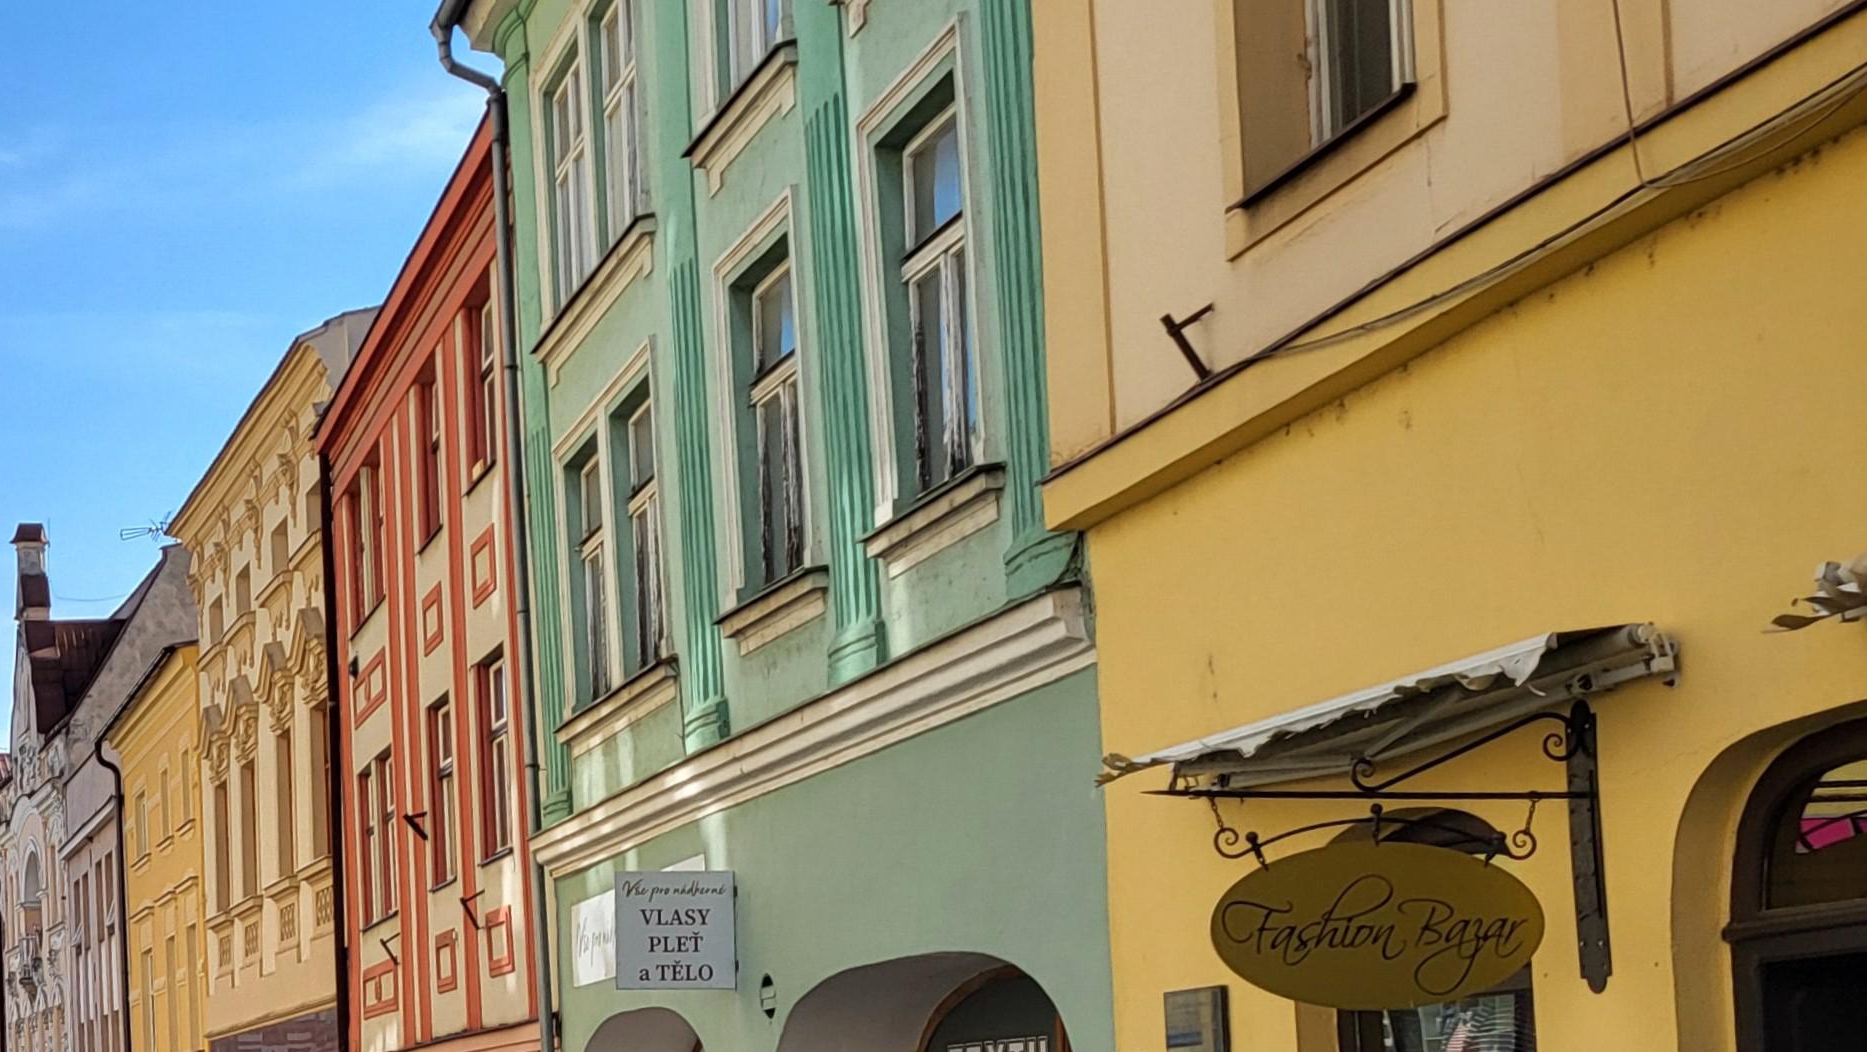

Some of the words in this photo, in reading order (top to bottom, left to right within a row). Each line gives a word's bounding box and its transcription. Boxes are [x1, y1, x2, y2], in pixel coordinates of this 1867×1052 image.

[621, 878, 649, 898] Vše
[649, 886, 670, 903] pro
[673, 880, 727, 897] nádherné
[639, 908, 711, 926] VLASY
[648, 931, 703, 953] PLEŤ
[1221, 873, 1407, 966] Fashion
[1397, 898, 1530, 996] Bazar
[639, 967, 651, 981] a
[656, 959, 714, 982] TĚLO
